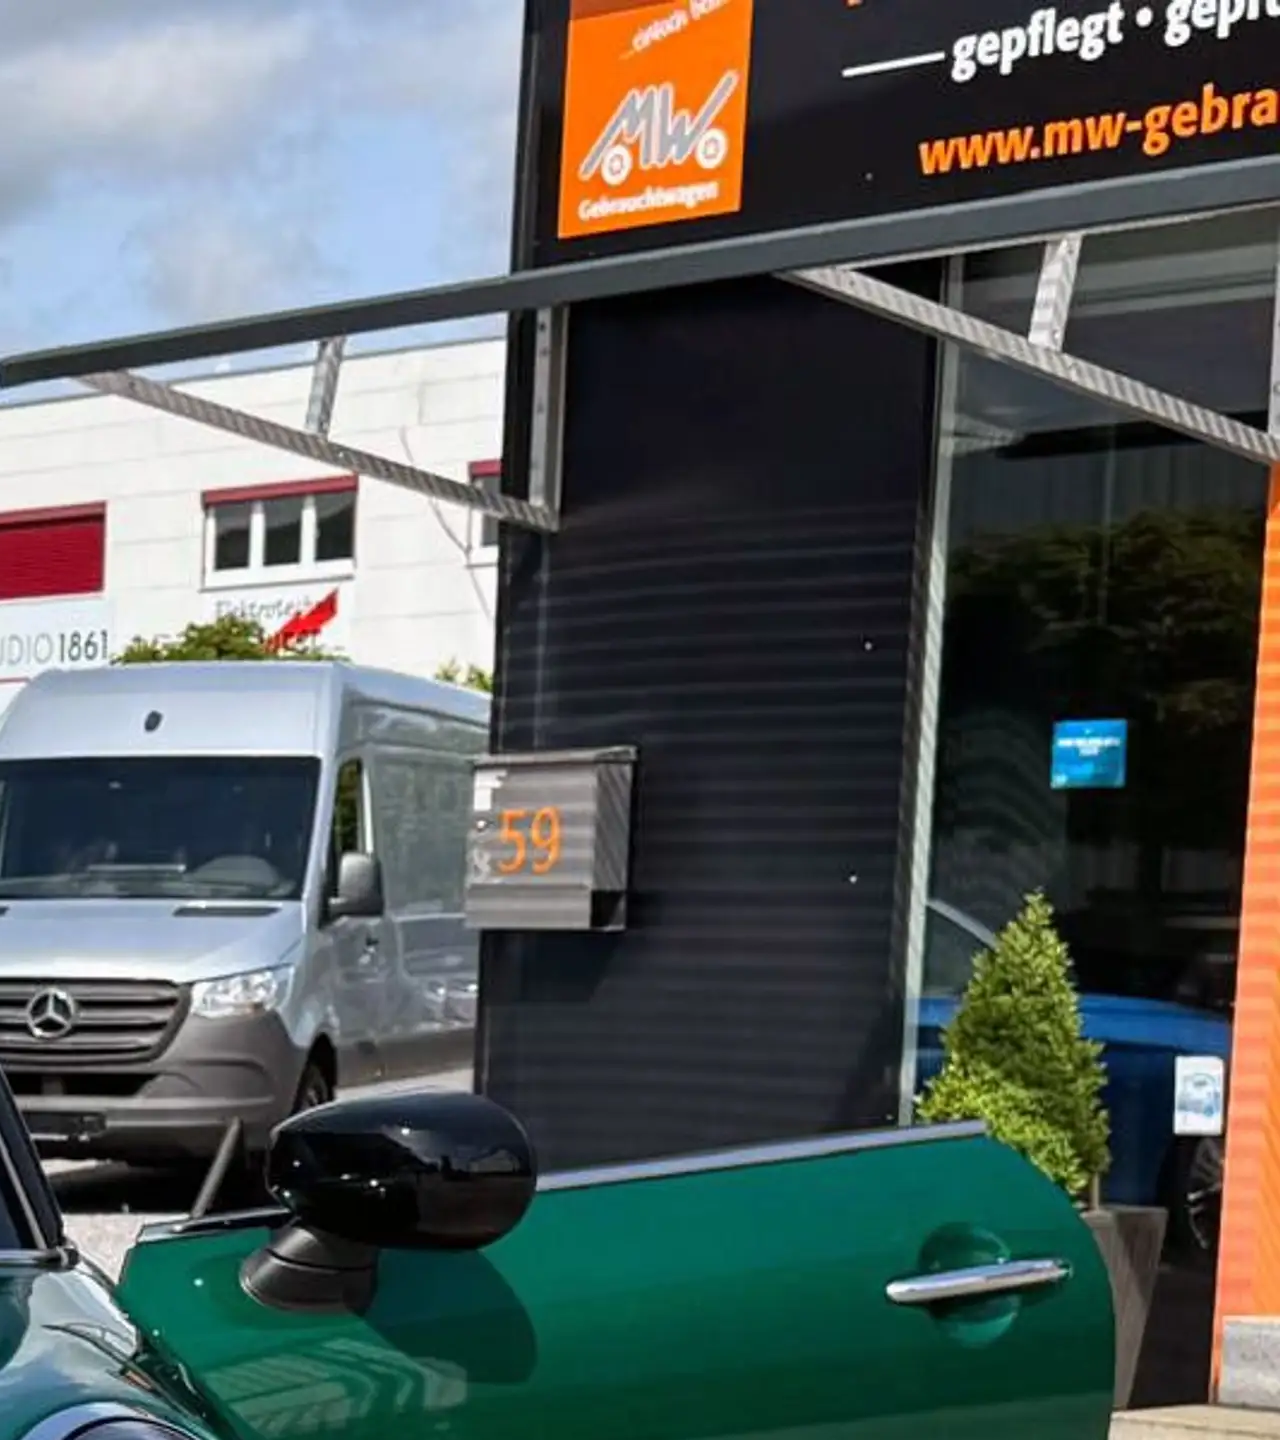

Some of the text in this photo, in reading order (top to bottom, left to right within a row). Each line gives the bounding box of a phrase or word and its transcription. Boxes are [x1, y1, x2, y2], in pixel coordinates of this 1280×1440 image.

[950, 0, 1280, 82] gepflegt gepr
[577, 180, 719, 220] Gebrauchtwagen
[58, 629, 109, 663] 1861
[497, 806, 563, 875] 59
